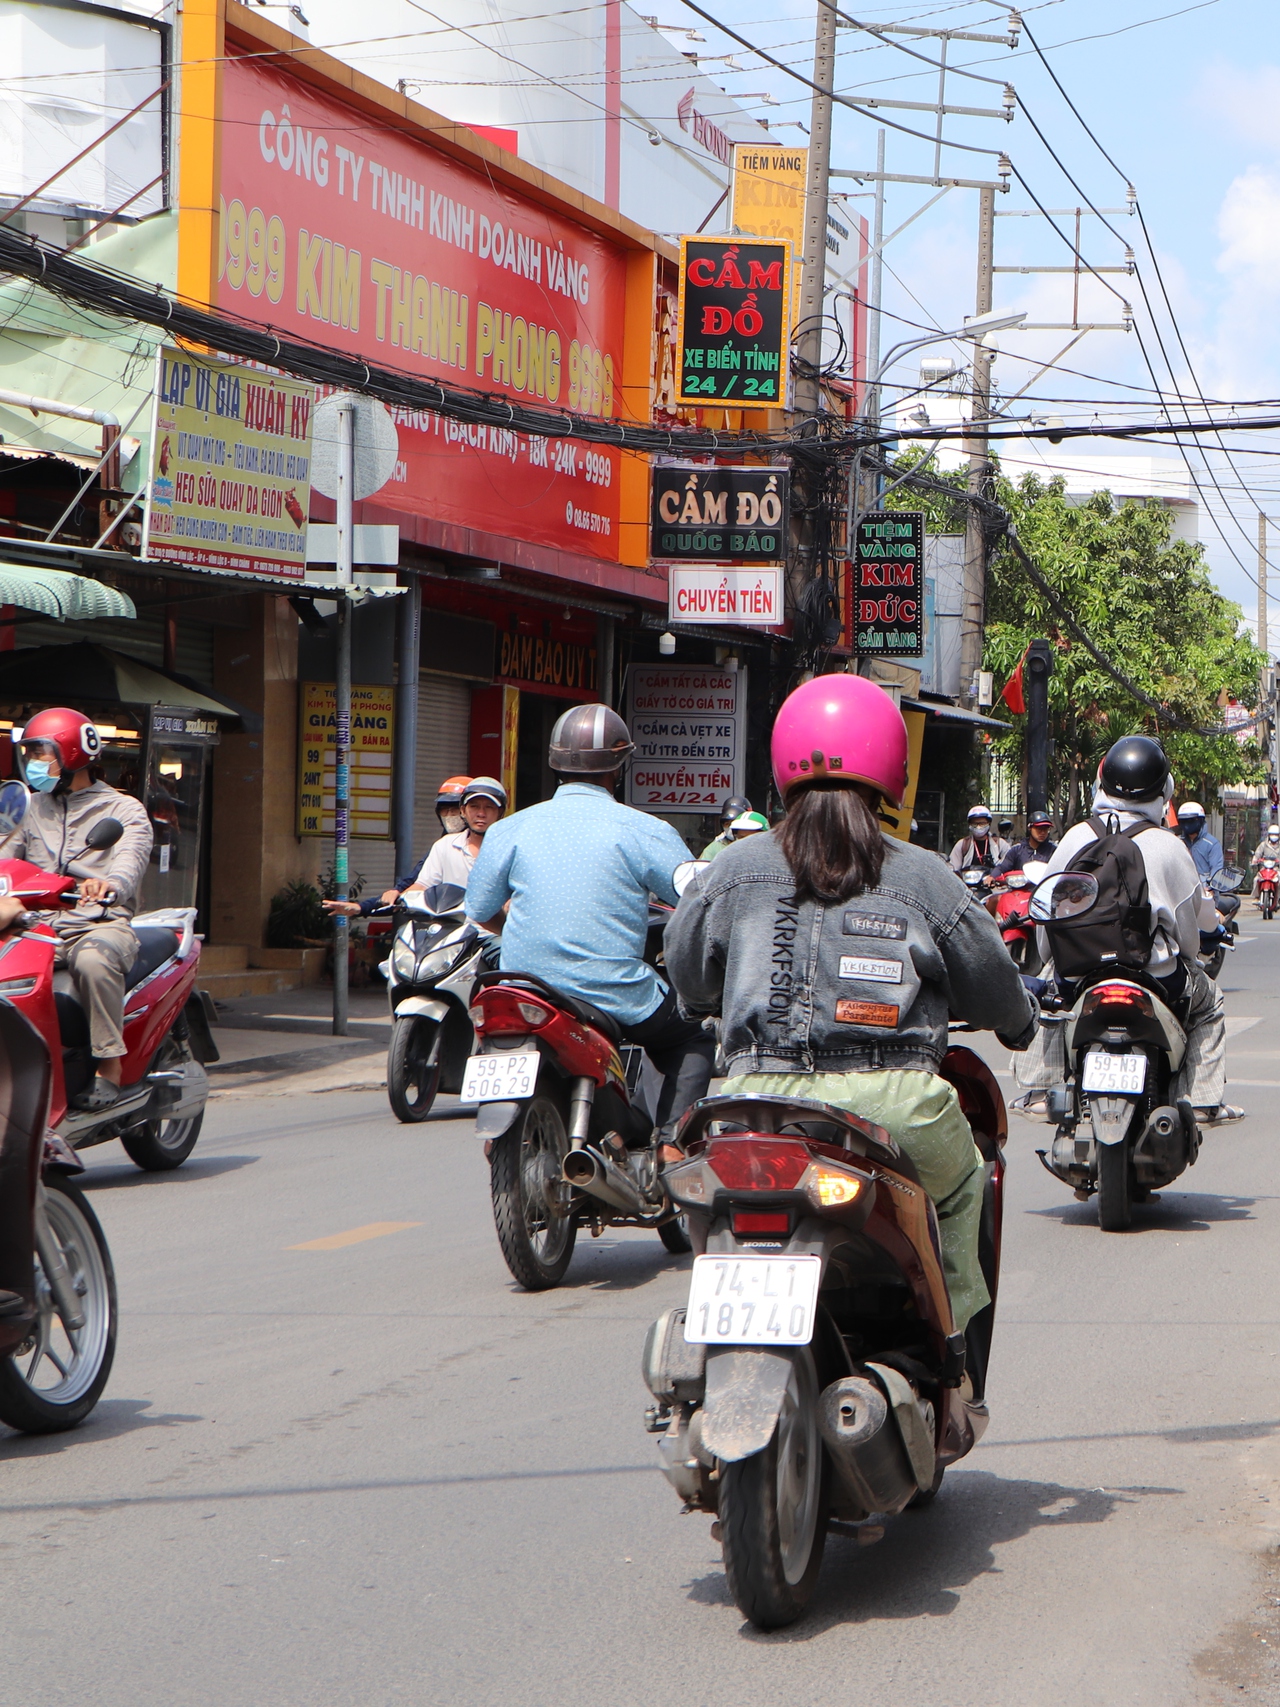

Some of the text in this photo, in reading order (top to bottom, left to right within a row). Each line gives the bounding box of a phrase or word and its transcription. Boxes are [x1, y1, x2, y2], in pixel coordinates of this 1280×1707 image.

[742, 149, 801, 173] TIỆM VÀNG
[259, 103, 589, 304] CÔNG TY TNHH KINH DOANH VÀNG
[740, 180, 799, 209] KIM
[687, 245, 782, 291] CẦM
[218, 192, 614, 420] 999 KIM THANH PHONG 9999
[701, 293, 764, 337] ĐỒ
[684, 340, 779, 372] XE BIỂN TỈNH
[684, 375, 776, 397] 24 24
[161, 358, 191, 417] LẠP
[196, 366, 212, 424] VỊ
[216, 372, 241, 420] GIA
[244, 379, 287, 436] XUÂN
[290, 389, 311, 442] KÝ
[529, 434, 549, 468] 18K
[585, 450, 612, 488] 9999
[175, 470, 258, 515] HEO SỮA QUAY DA
[659, 473, 782, 527] CẦM ĐỒ
[574, 508, 610, 536] 08.66 570 716
[862, 520, 913, 540] TIỆM
[661, 529, 776, 552] QUỐC BẢO
[858, 539, 917, 558] VÀNG
[860, 563, 914, 587] KIM
[677, 578, 773, 614] CHUYỂN TIỀN
[858, 592, 917, 623] ĐỨC
[858, 626, 917, 648] CẦM VÀNG
[566, 644, 585, 688] UY
[646, 672, 732, 689] CẦM TẤT CẢ CÁC
[307, 700, 392, 711] KIM PHONG
[636, 692, 734, 713] GIẤY TỜ CÓ GIÁ TRỊ
[309, 714, 336, 727] GIÁ
[670, 722, 687, 736] CÀ
[690, 725, 712, 740] VẸT
[715, 726, 731, 737] XE
[84, 726, 98, 751] 8
[362, 733, 390, 745] BÁN RA
[641, 741, 730, 758] TỪ 1TR ĐẾN 5TR
[307, 750, 319, 763] 99
[304, 772, 321, 786] 24NT
[635, 766, 731, 788] CHUYỂN TIỀN
[301, 794, 312, 808] CTY
[647, 791, 718, 804] 24/24
[303, 816, 318, 830] 18K
[766, 896, 800, 1026] VKRKFSION
[842, 1010, 894, 1023] Parachute
[477, 1056, 528, 1077] 59-P2
[1094, 1055, 1137, 1073] 59-N3
[467, 1076, 530, 1098] 506.29
[714, 1262, 797, 1297] 74-L1
[699, 1302, 806, 1337] 187.40
